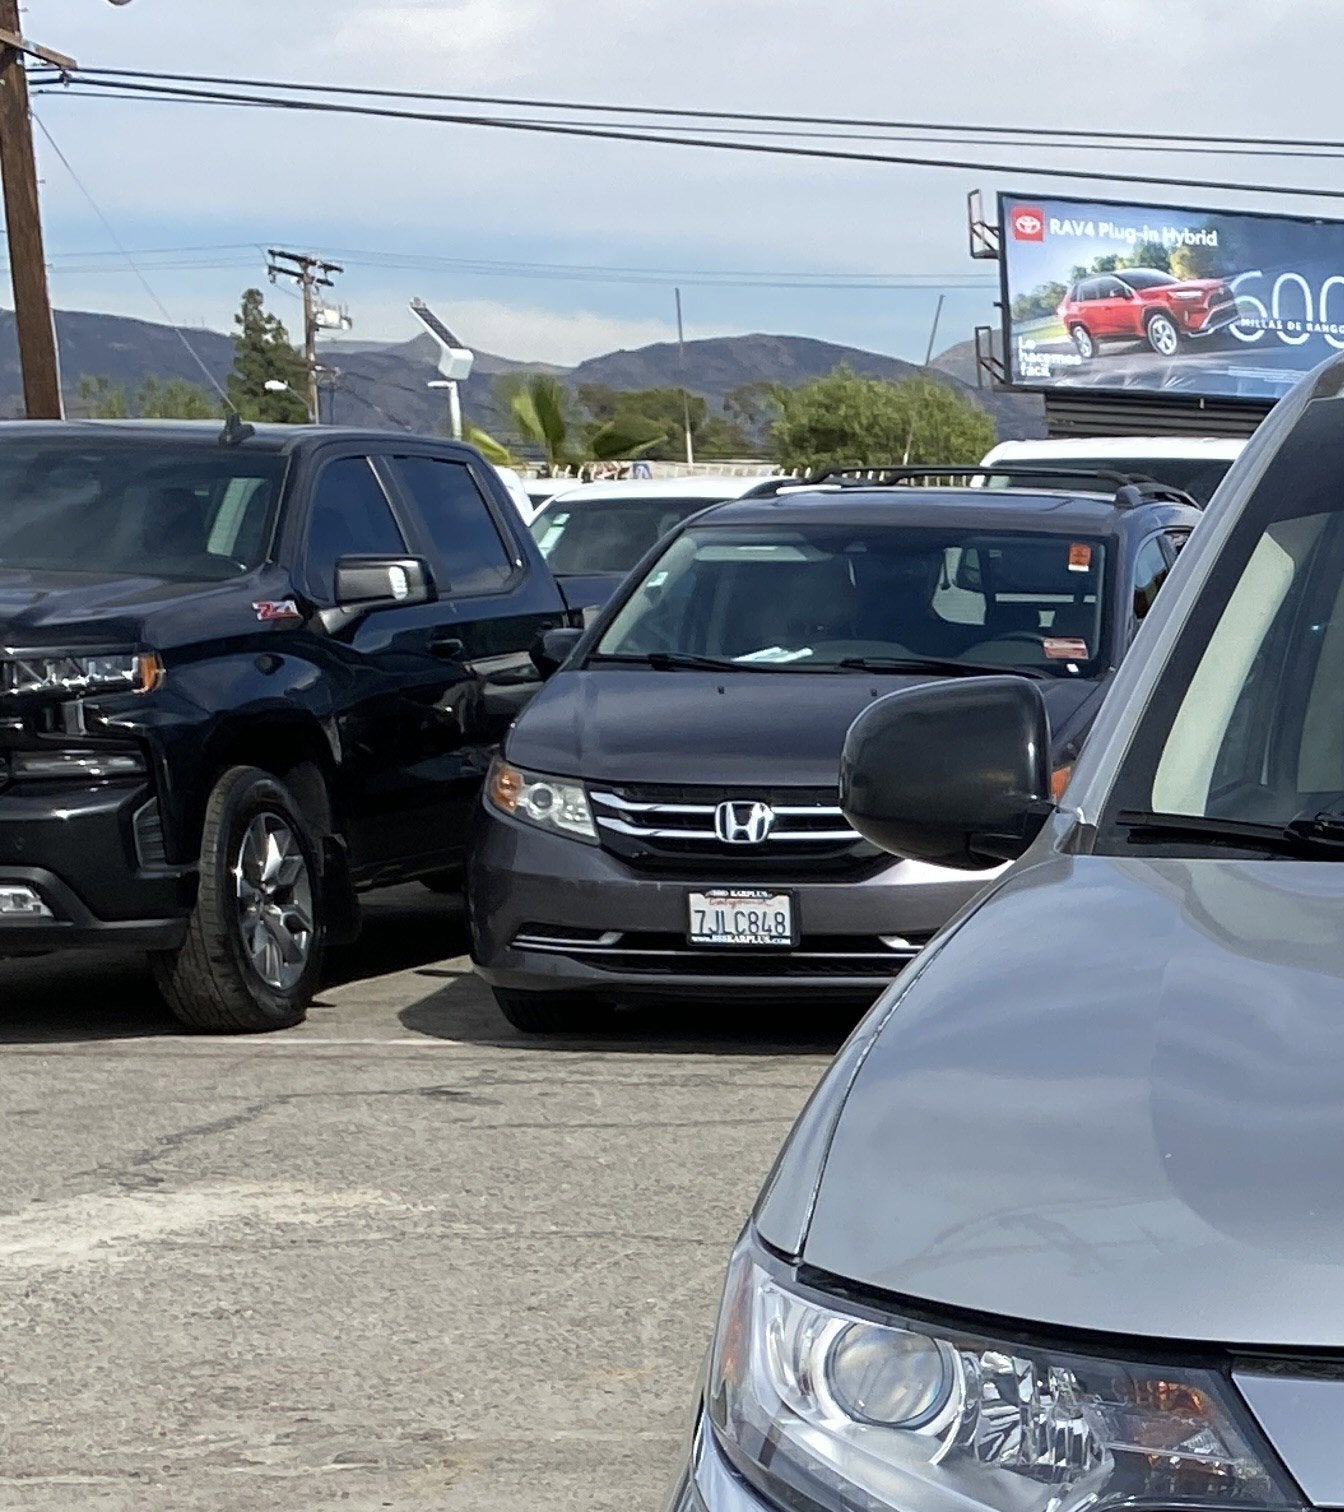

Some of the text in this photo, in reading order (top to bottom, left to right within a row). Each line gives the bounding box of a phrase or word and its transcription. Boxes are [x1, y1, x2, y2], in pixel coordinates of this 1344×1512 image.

[1050, 218, 1218, 247] RAV4 Plug-in Hybrid
[1287, 320, 1301, 331] DE
[694, 910, 786, 936] 7JLC848
